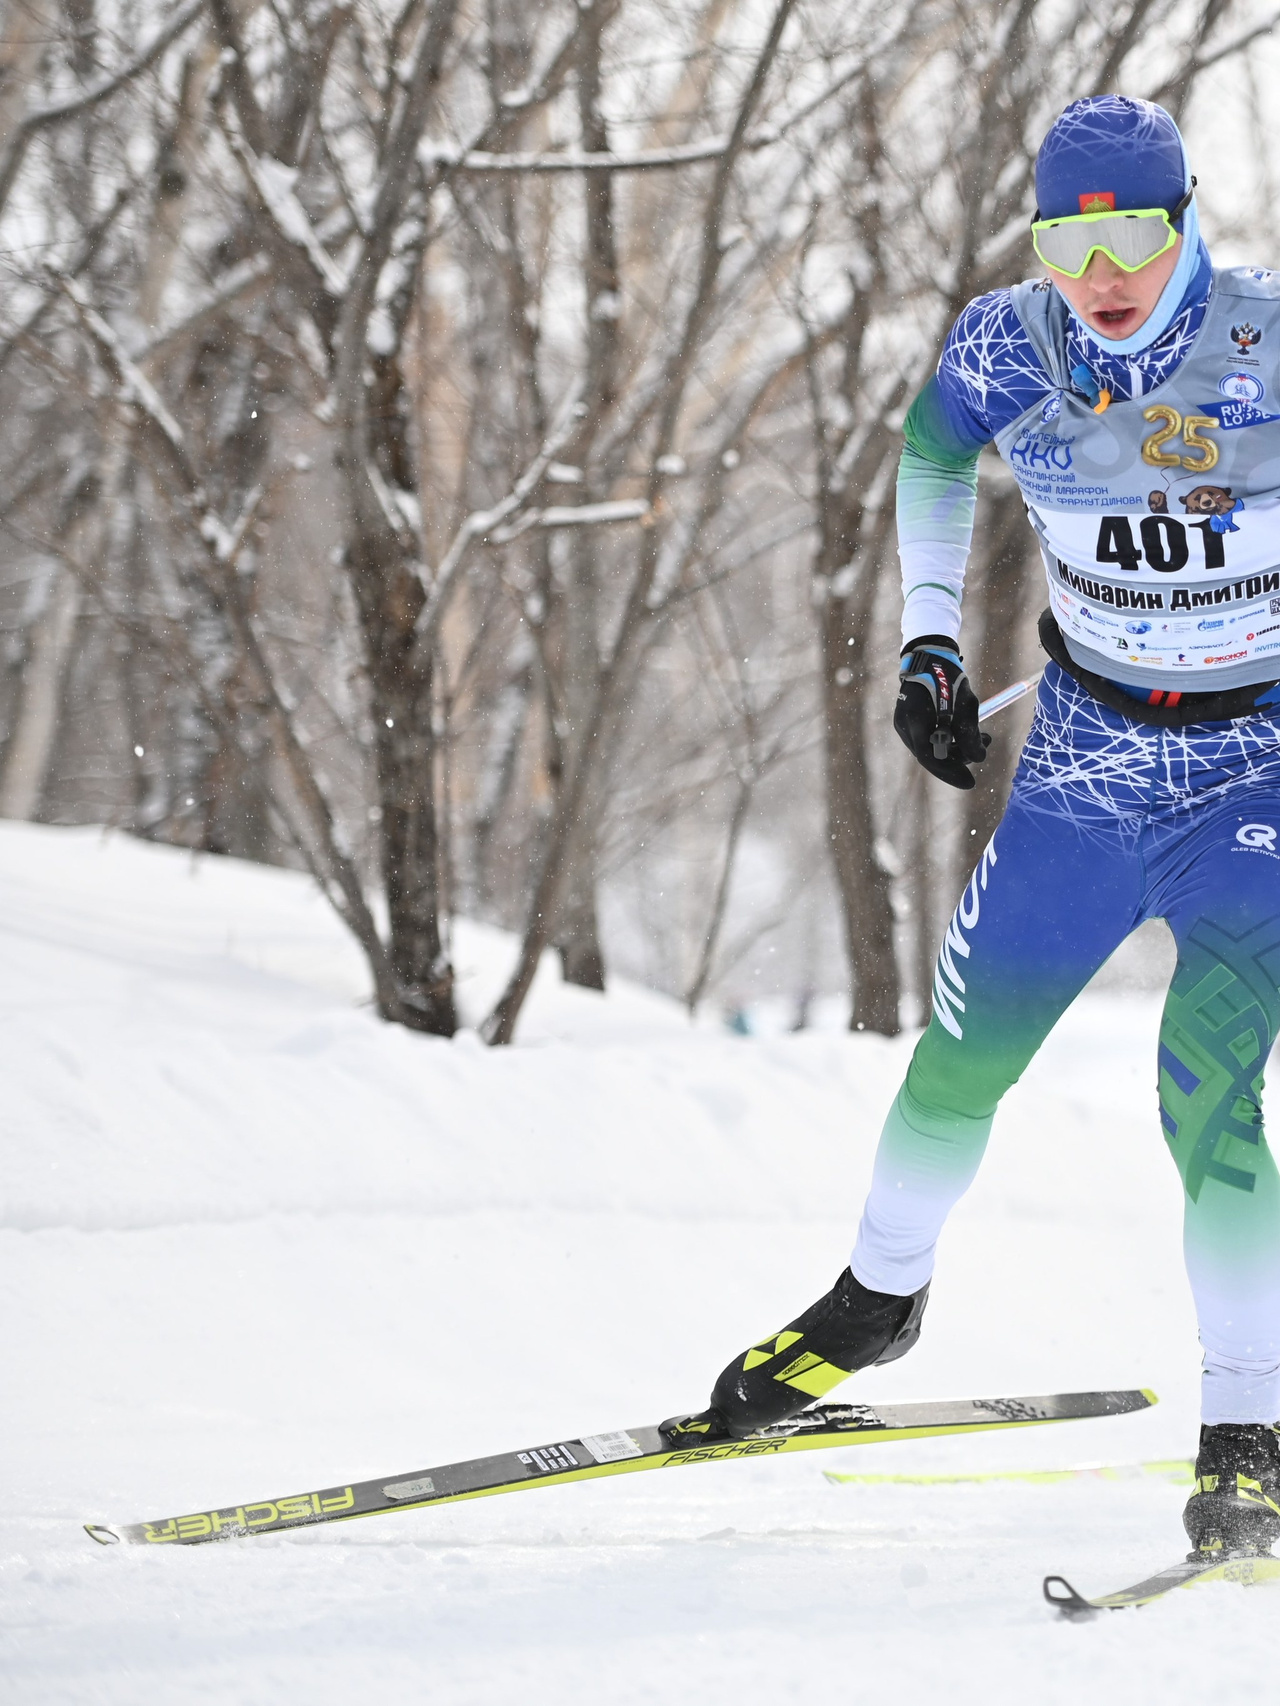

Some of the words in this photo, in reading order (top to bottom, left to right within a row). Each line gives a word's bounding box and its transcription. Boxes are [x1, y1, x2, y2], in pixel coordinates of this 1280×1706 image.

[1142, 404, 1219, 472] 25
[1056, 486, 1108, 495] МАРАФОН
[1056, 496, 1143, 507] ФАРХУТДИНОВА
[1096, 515, 1225, 572] 401
[1056, 557, 1164, 610] Мишарин
[662, 1439, 788, 1467] FISCHER
[140, 1487, 354, 1544] FISCHER
